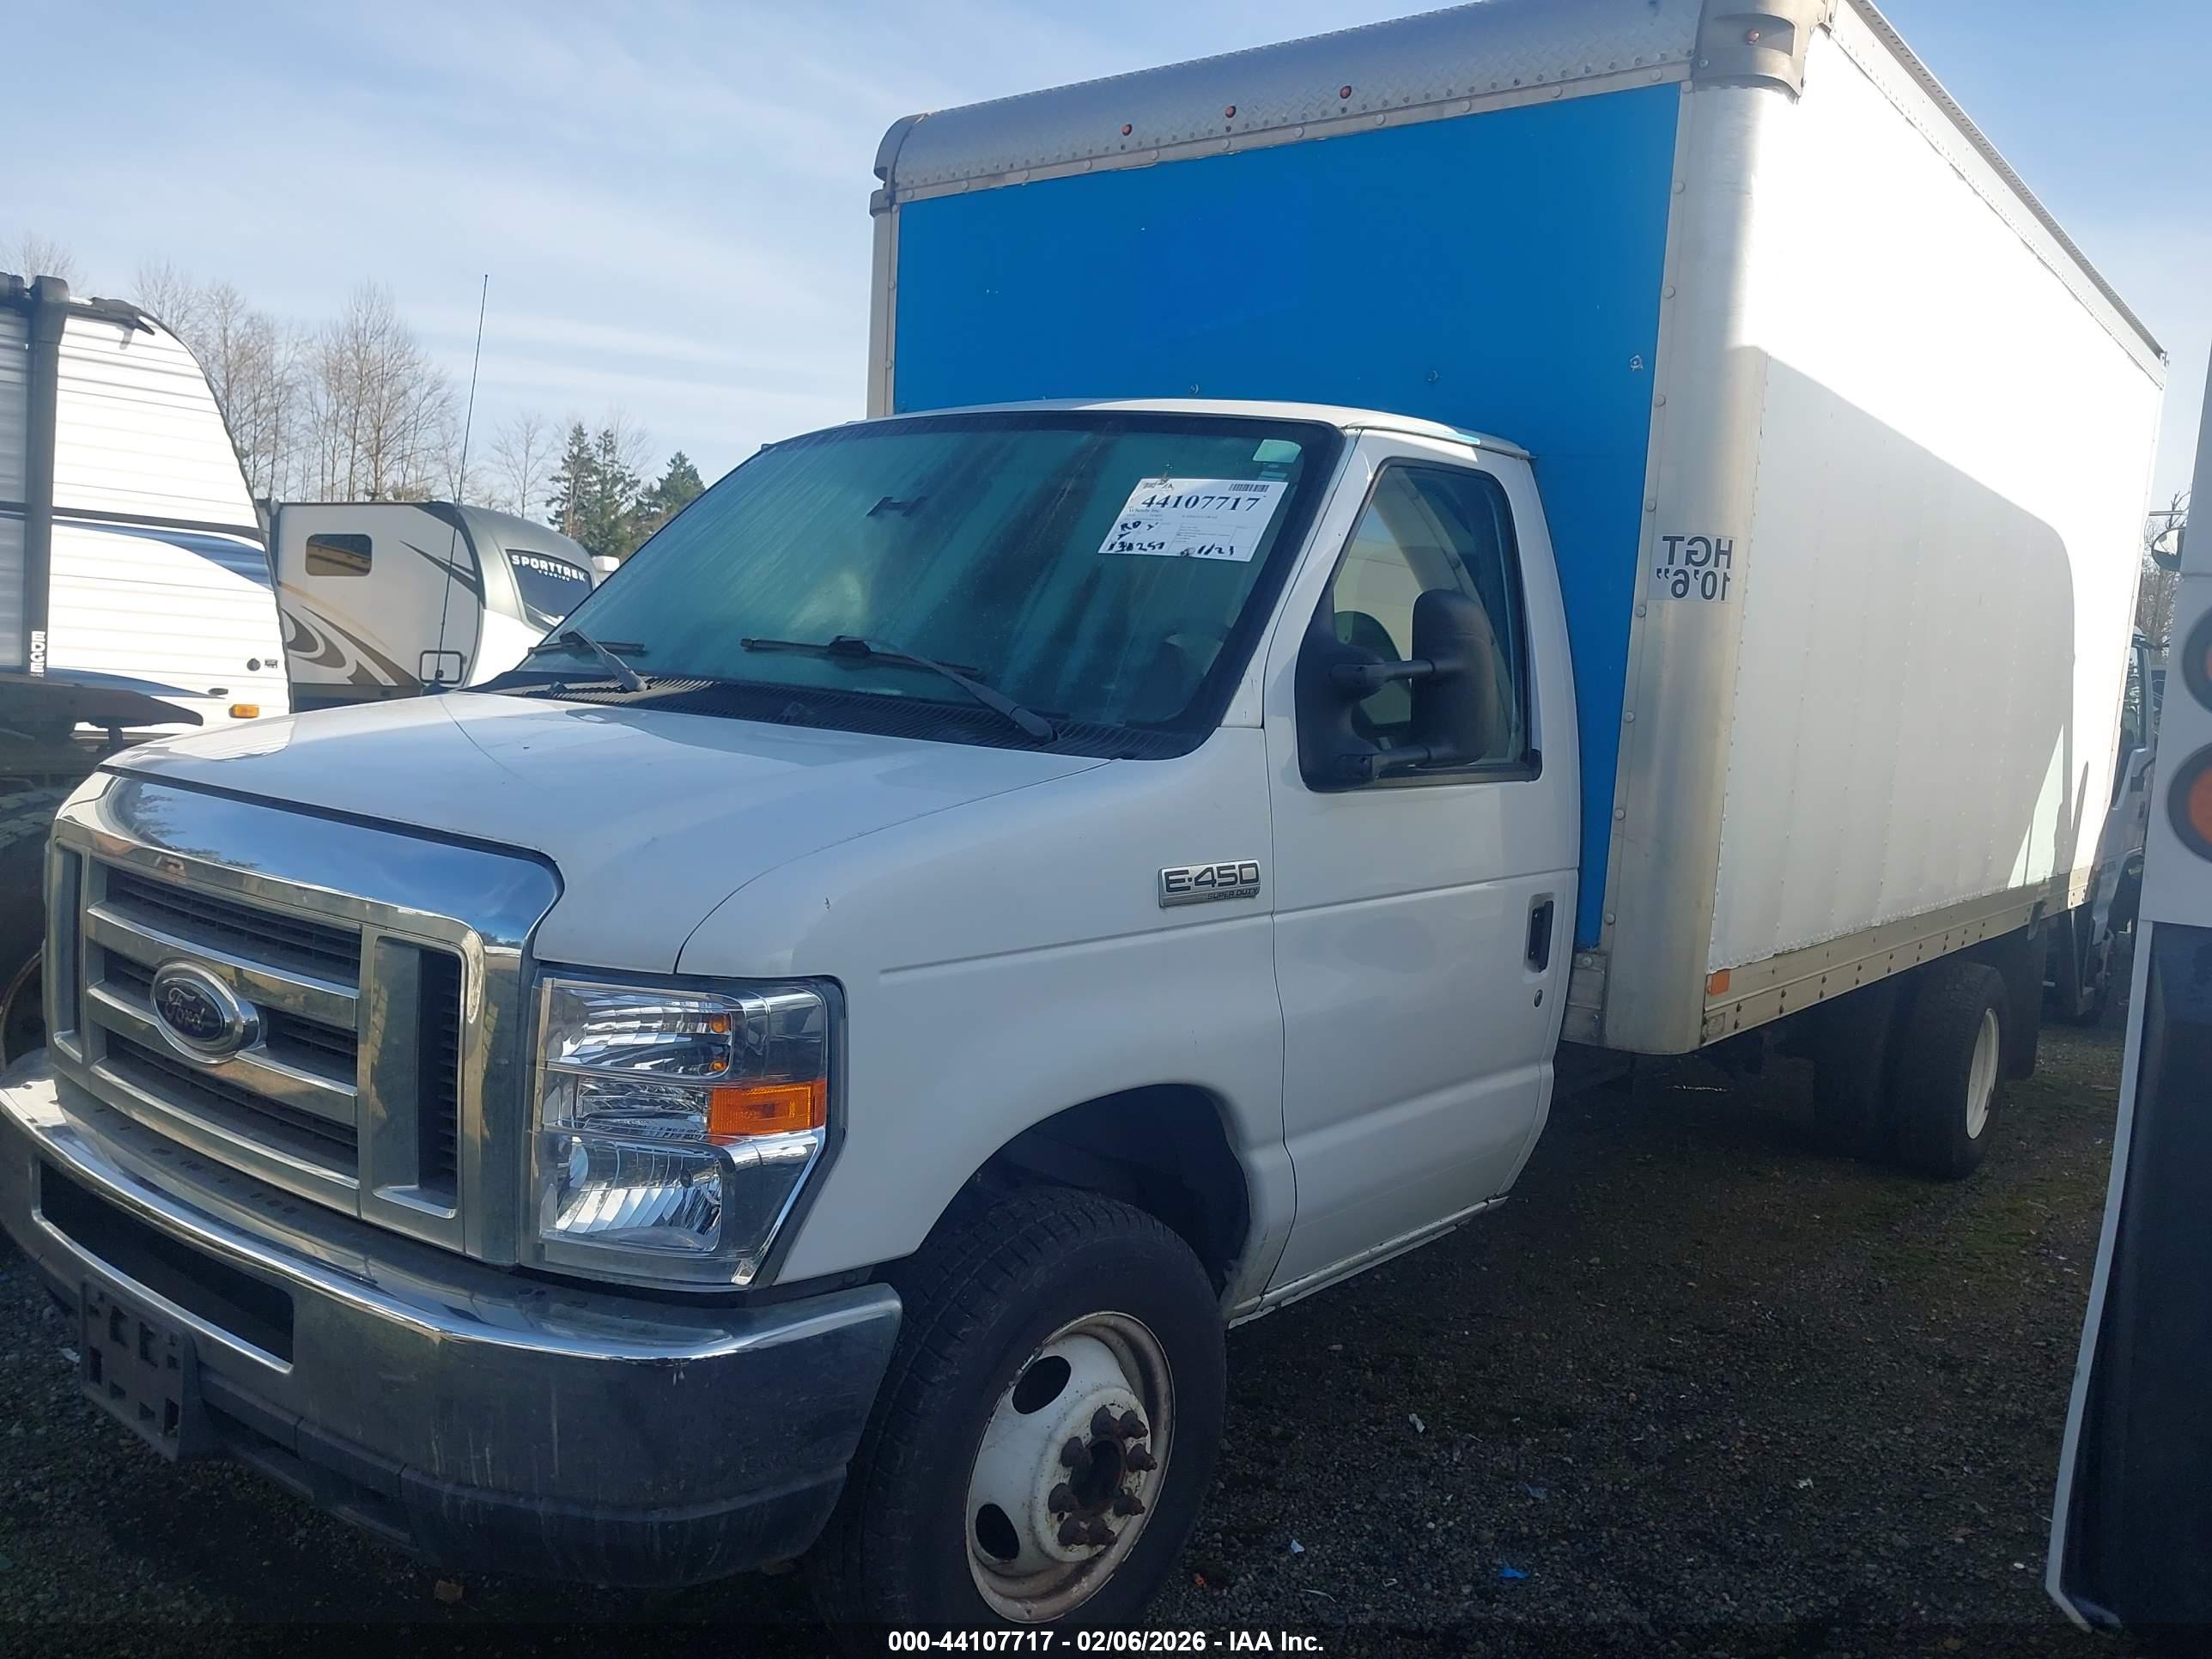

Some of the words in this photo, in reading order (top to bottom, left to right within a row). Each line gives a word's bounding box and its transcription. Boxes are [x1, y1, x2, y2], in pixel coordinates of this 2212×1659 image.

[1141, 495, 1261, 512] 44107717
[512, 555, 586, 582] SPORTTREK
[1164, 862, 1260, 892] E-450
[1207, 891, 1235, 900] SUPER
[1236, 886, 1260, 896] DUTY
